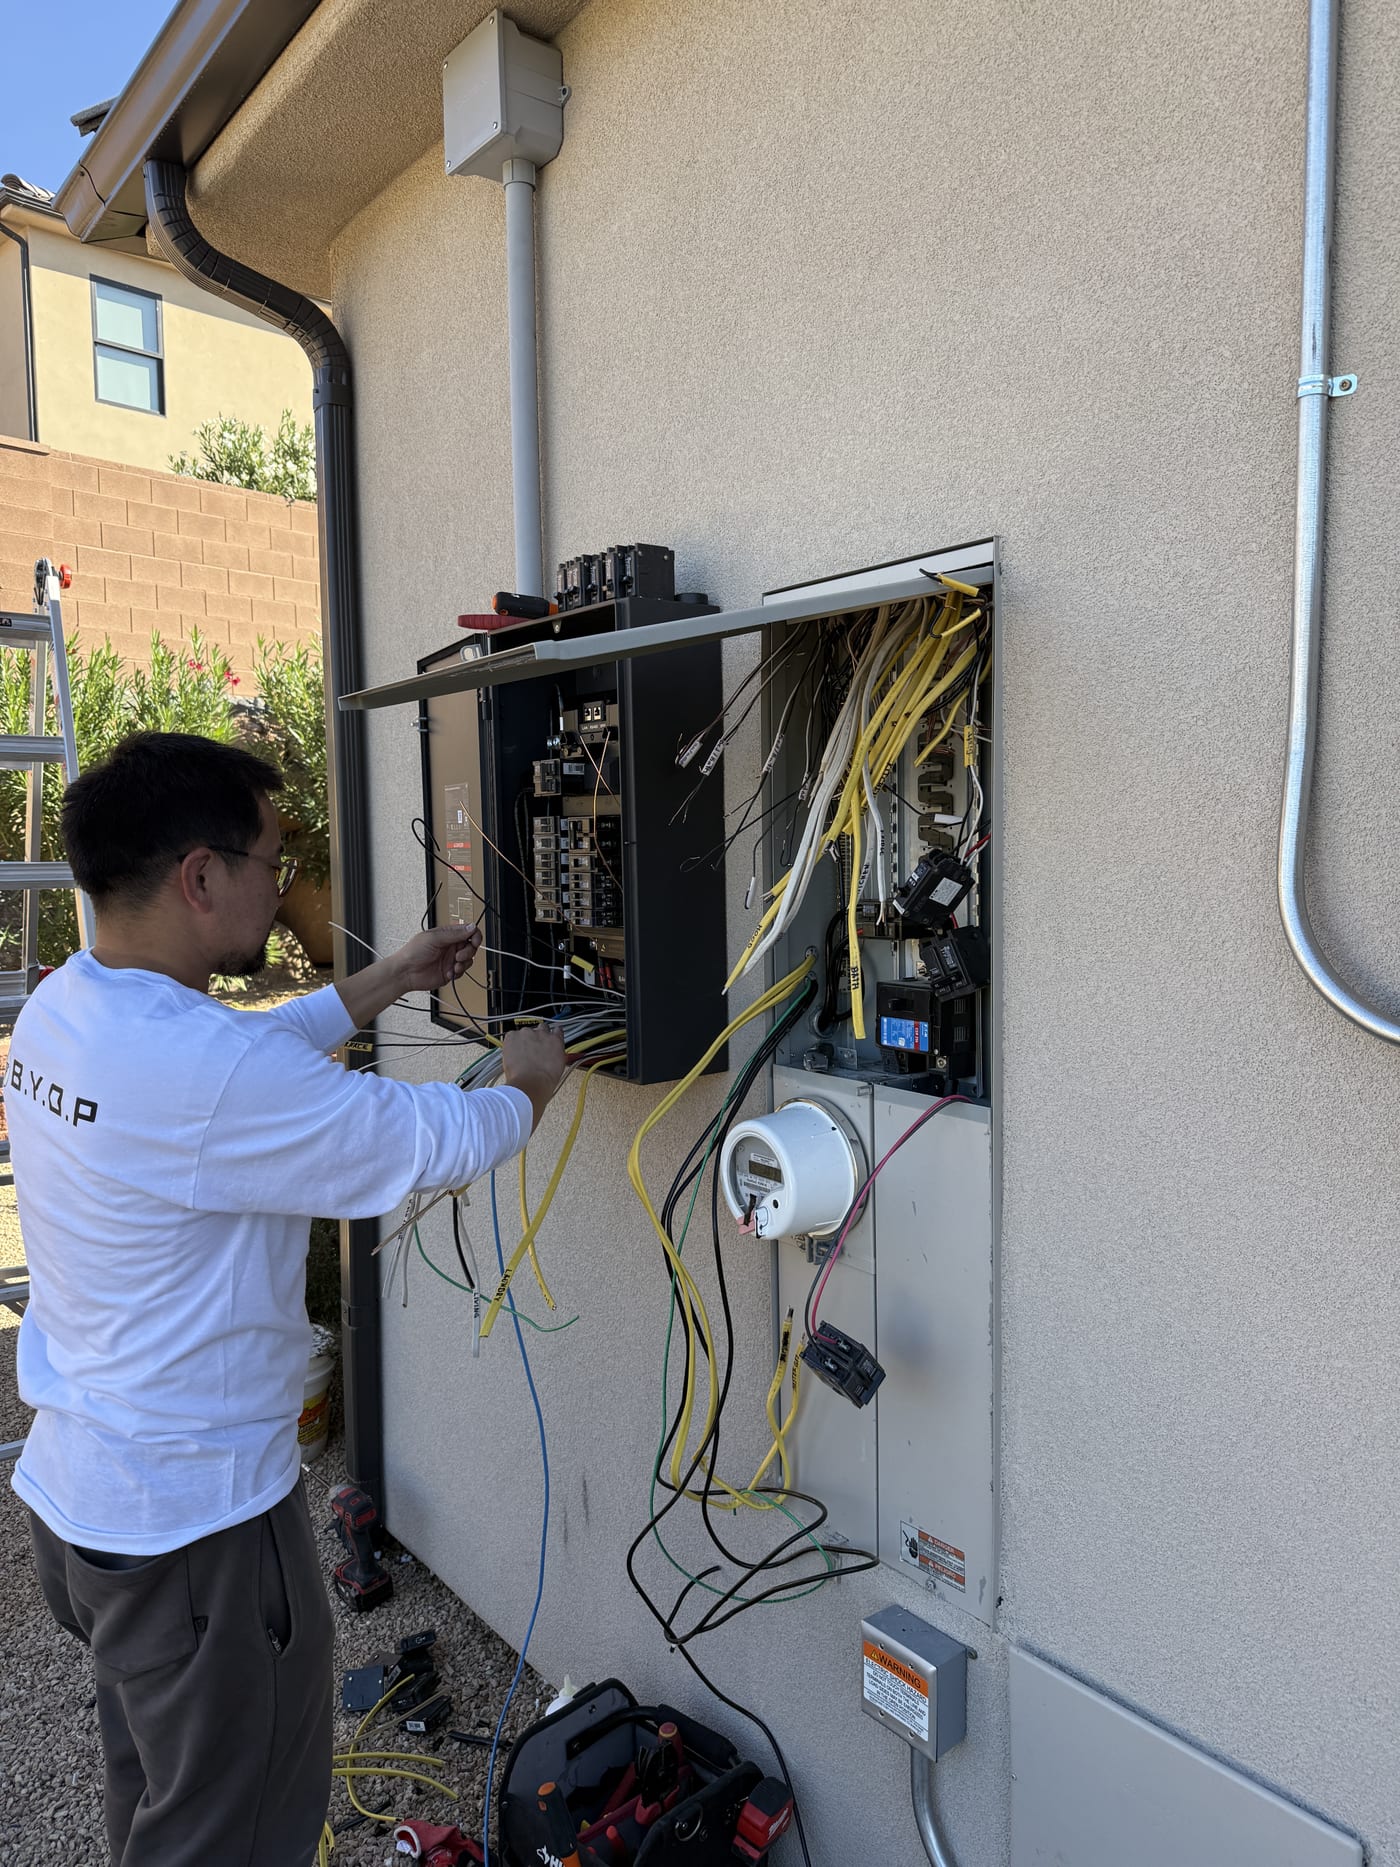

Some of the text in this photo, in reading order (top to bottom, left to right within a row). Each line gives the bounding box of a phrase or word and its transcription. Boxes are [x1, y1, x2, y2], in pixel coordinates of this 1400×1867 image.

[851, 967, 860, 990] BATH
[494, 1269, 513, 1302] LAUNDRY
[879, 1652, 921, 1689] WARNING
